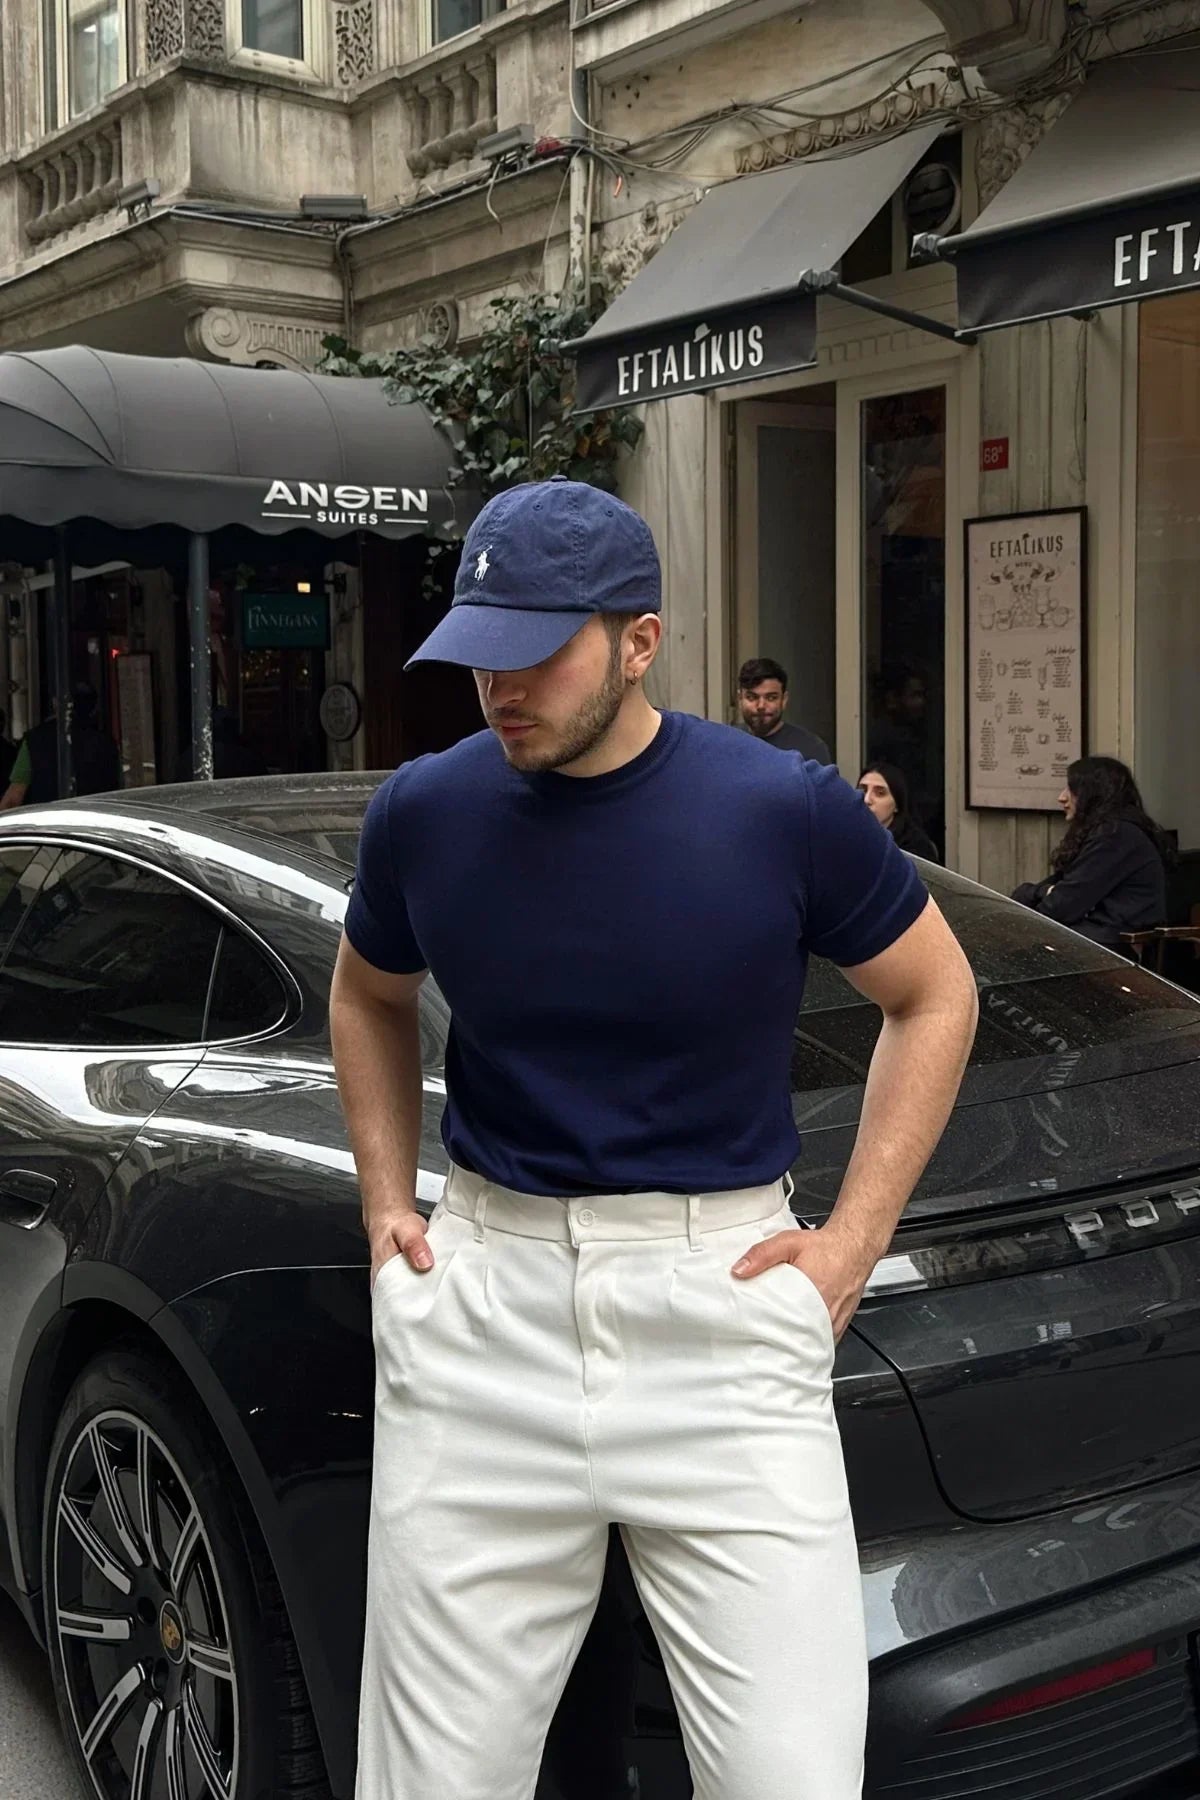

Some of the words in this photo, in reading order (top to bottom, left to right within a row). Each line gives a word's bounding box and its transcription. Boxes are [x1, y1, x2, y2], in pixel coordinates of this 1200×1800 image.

[1114, 221, 1200, 287] EFT
[263, 480, 428, 512] ANSEN
[316, 511, 379, 525] SUITES
